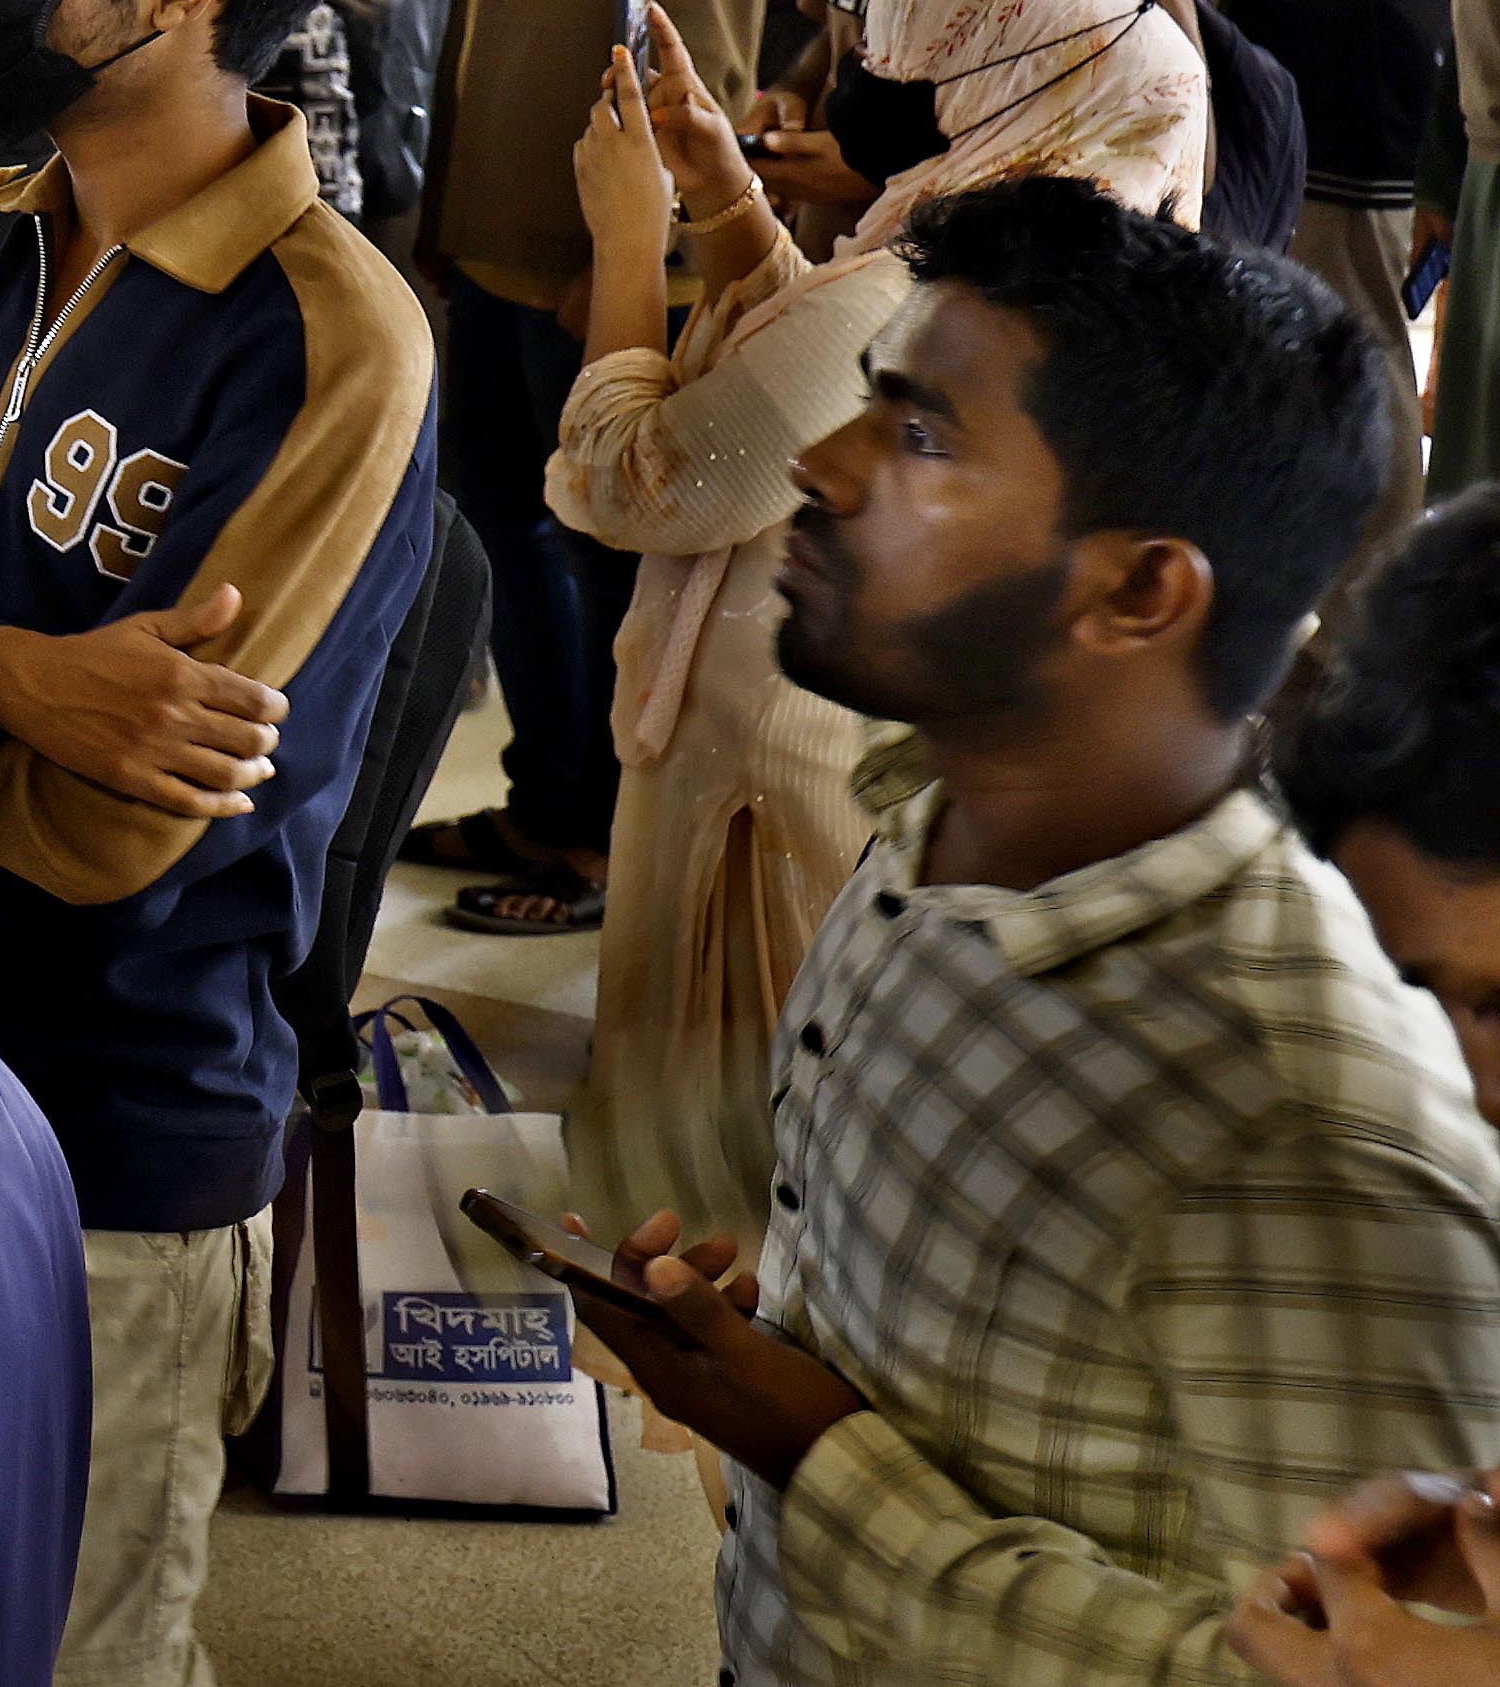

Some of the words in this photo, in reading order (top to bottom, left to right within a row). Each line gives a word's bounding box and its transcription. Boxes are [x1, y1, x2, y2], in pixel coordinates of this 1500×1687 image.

[26, 408, 190, 581] 99
[388, 1335, 445, 1373] আই
[452, 1335, 561, 1375] হসপিটাল
